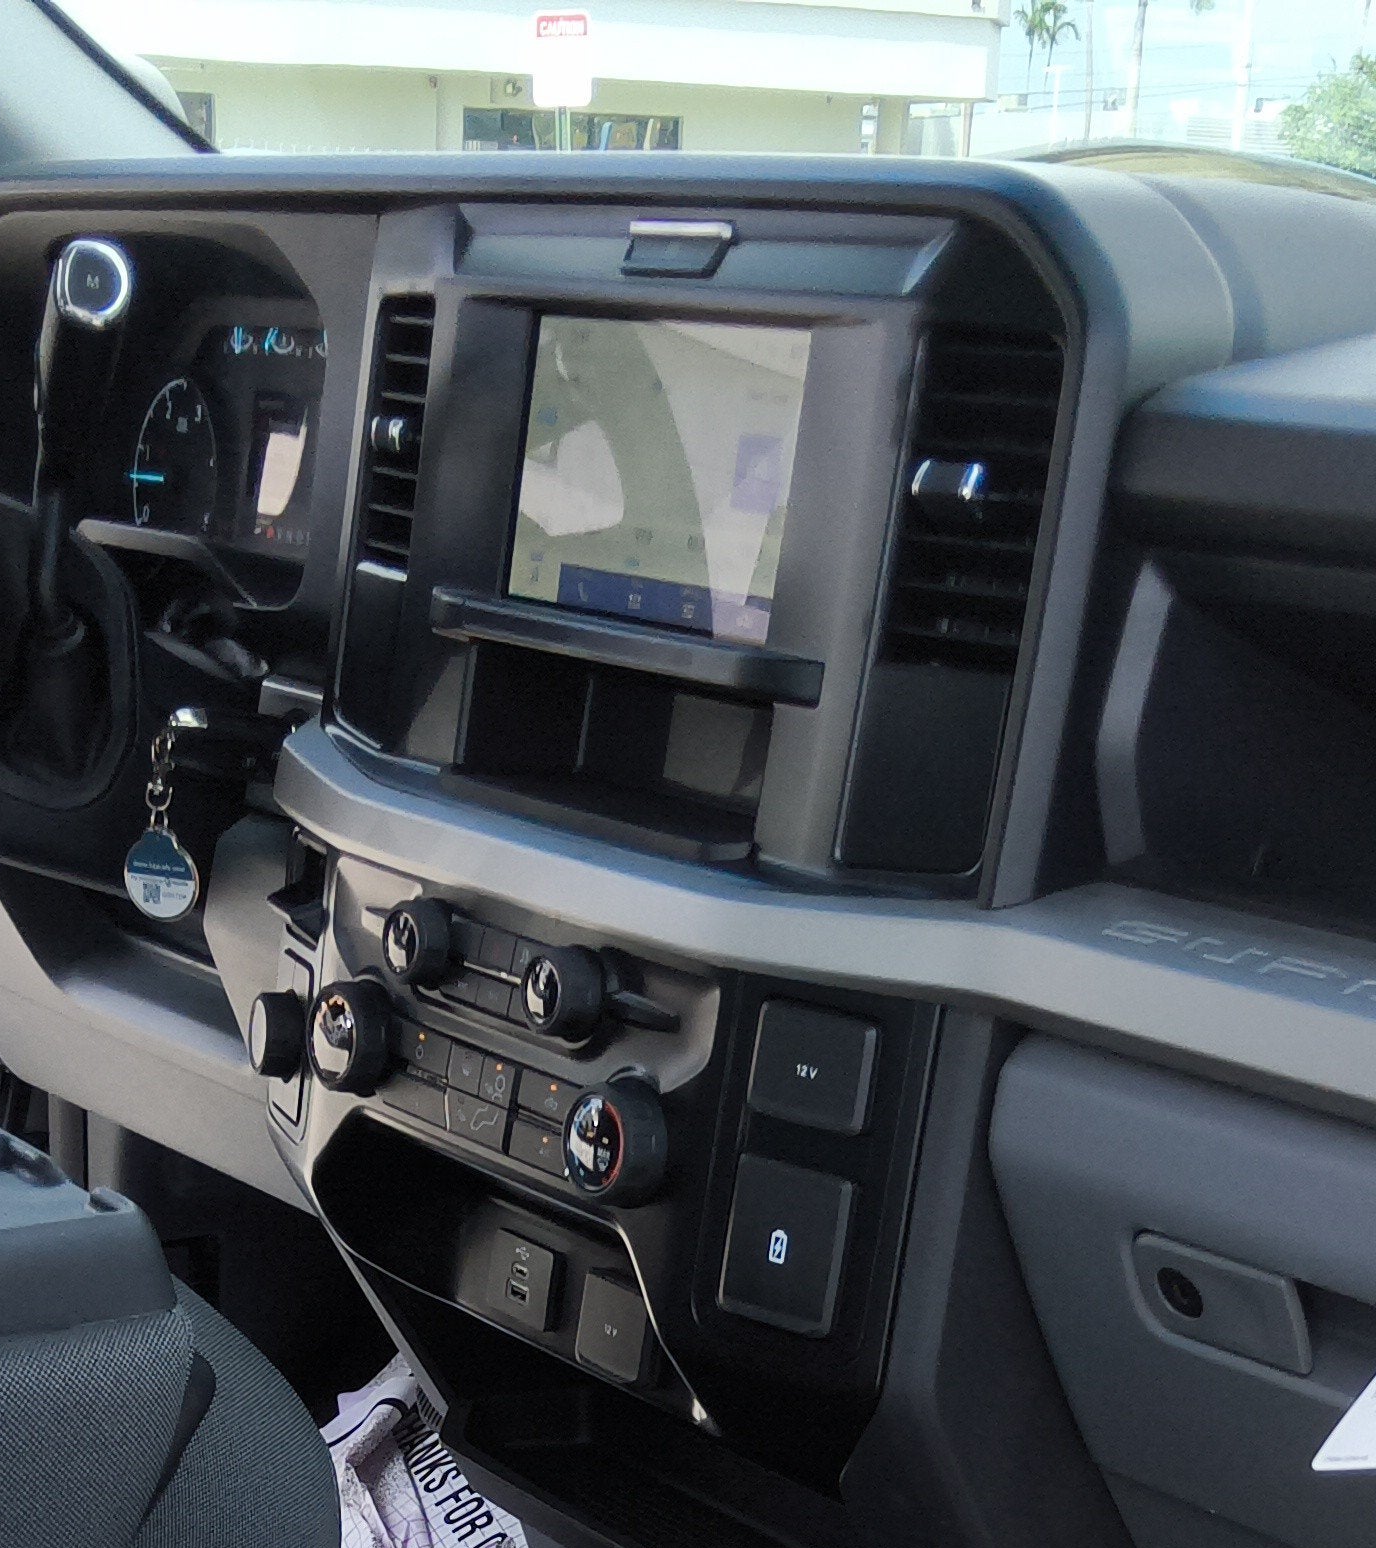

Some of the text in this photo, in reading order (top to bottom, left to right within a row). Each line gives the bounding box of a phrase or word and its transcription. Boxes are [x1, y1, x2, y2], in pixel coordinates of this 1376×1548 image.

[796, 1063, 819, 1080] 12V
[391, 1404, 494, 1543] HANKS FOR
